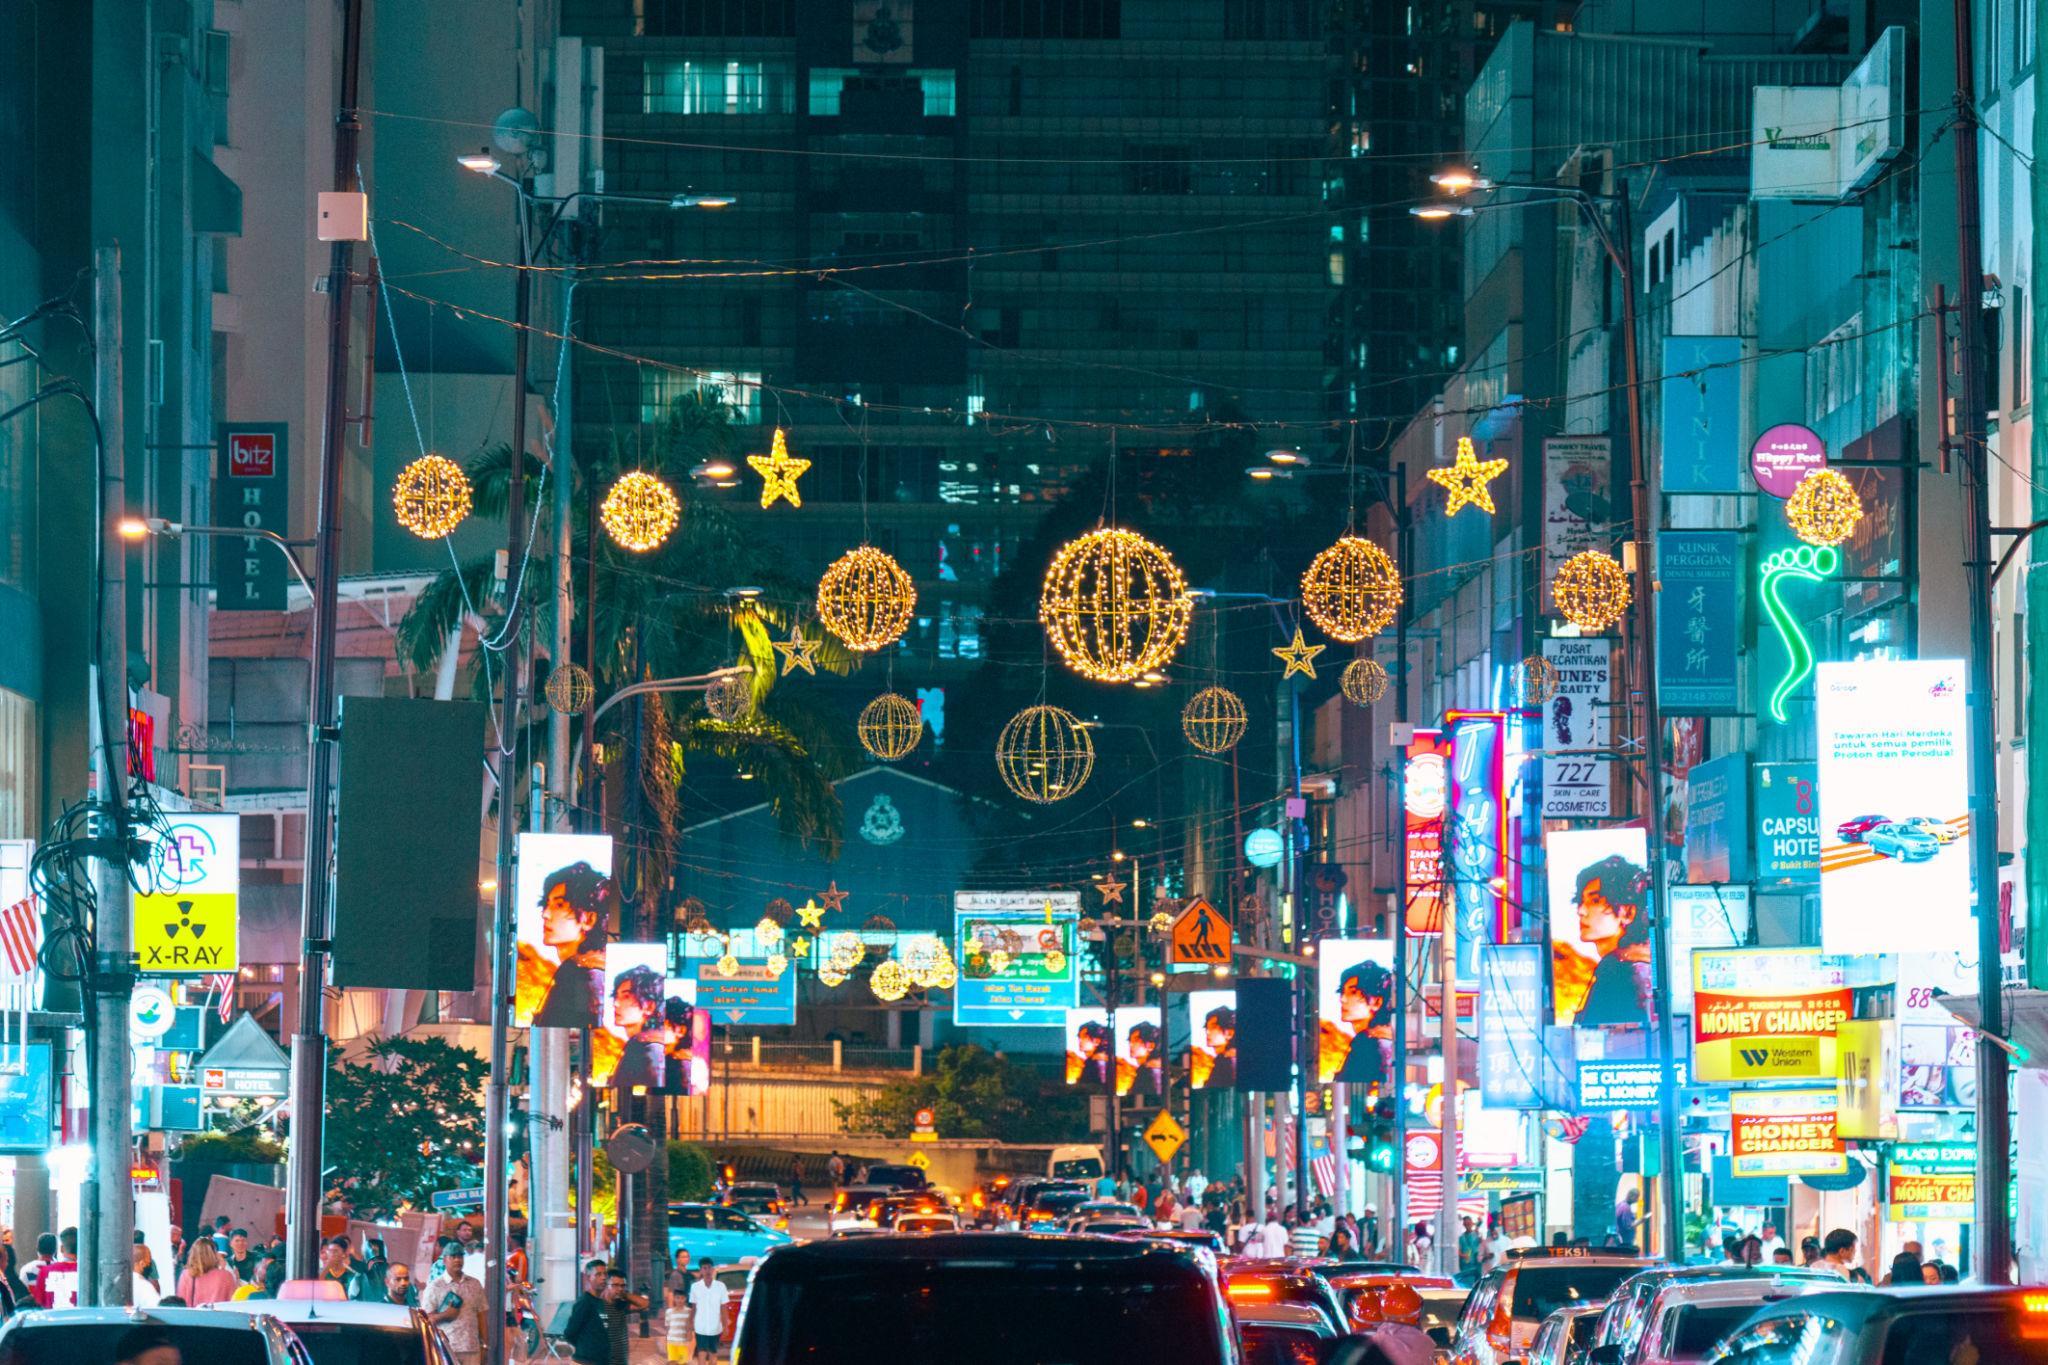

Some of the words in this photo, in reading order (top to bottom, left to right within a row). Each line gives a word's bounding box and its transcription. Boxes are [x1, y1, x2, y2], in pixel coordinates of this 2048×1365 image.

[233, 439, 272, 465] bitz
[243, 487, 262, 600] HOTEL
[1678, 542, 1720, 554] KLINIK
[1665, 554, 1732, 566] PERGIGIAN
[1664, 570, 1695, 578] DENTAL
[1696, 570, 1731, 578] SURGERY
[1559, 643, 1593, 654] PUSAT
[1558, 669, 1608, 683] UNE'S
[1834, 731, 1879, 741] Tawaran
[1881, 730, 1903, 739] Hari
[1906, 729, 1954, 738] Merdeka
[1834, 740, 1867, 749] untuk
[1871, 740, 1908, 748] semua
[1911, 738, 1952, 750] pemilik
[1833, 751, 1873, 760] Proton
[1876, 750, 1899, 759] dan
[1556, 762, 1597, 782] 727
[1553, 789, 1571, 797] SKIN
[1579, 789, 1601, 797] CARE
[1795, 780, 1813, 815] 8
[1546, 801, 1608, 812] COSMETICS
[1762, 817, 1819, 836] CAPSU
[1773, 838, 1819, 857] HOTE
[1410, 850, 1442, 859] ZHAN
[1780, 861, 1802, 870] Bukit
[970, 897, 997, 905] JALAN
[147, 945, 223, 965] X-RAY
[720, 985, 749, 993] Sultan
[1484, 989, 1536, 1011] ZENITH
[1906, 987, 1933, 1009] 88
[1701, 1011, 1764, 1034] MONEY
[1771, 1048, 1812, 1057] Western
[1771, 1057, 1802, 1067] Union
[234, 1079, 274, 1091] HOTEL
[1740, 1122, 1836, 1141] MONEY
[1741, 1138, 1835, 1153] CHANGER
[1895, 1148, 1939, 1161] PLACID
[1894, 1185, 1945, 1203] MONEY
[1946, 1184, 1974, 1202] CHA
